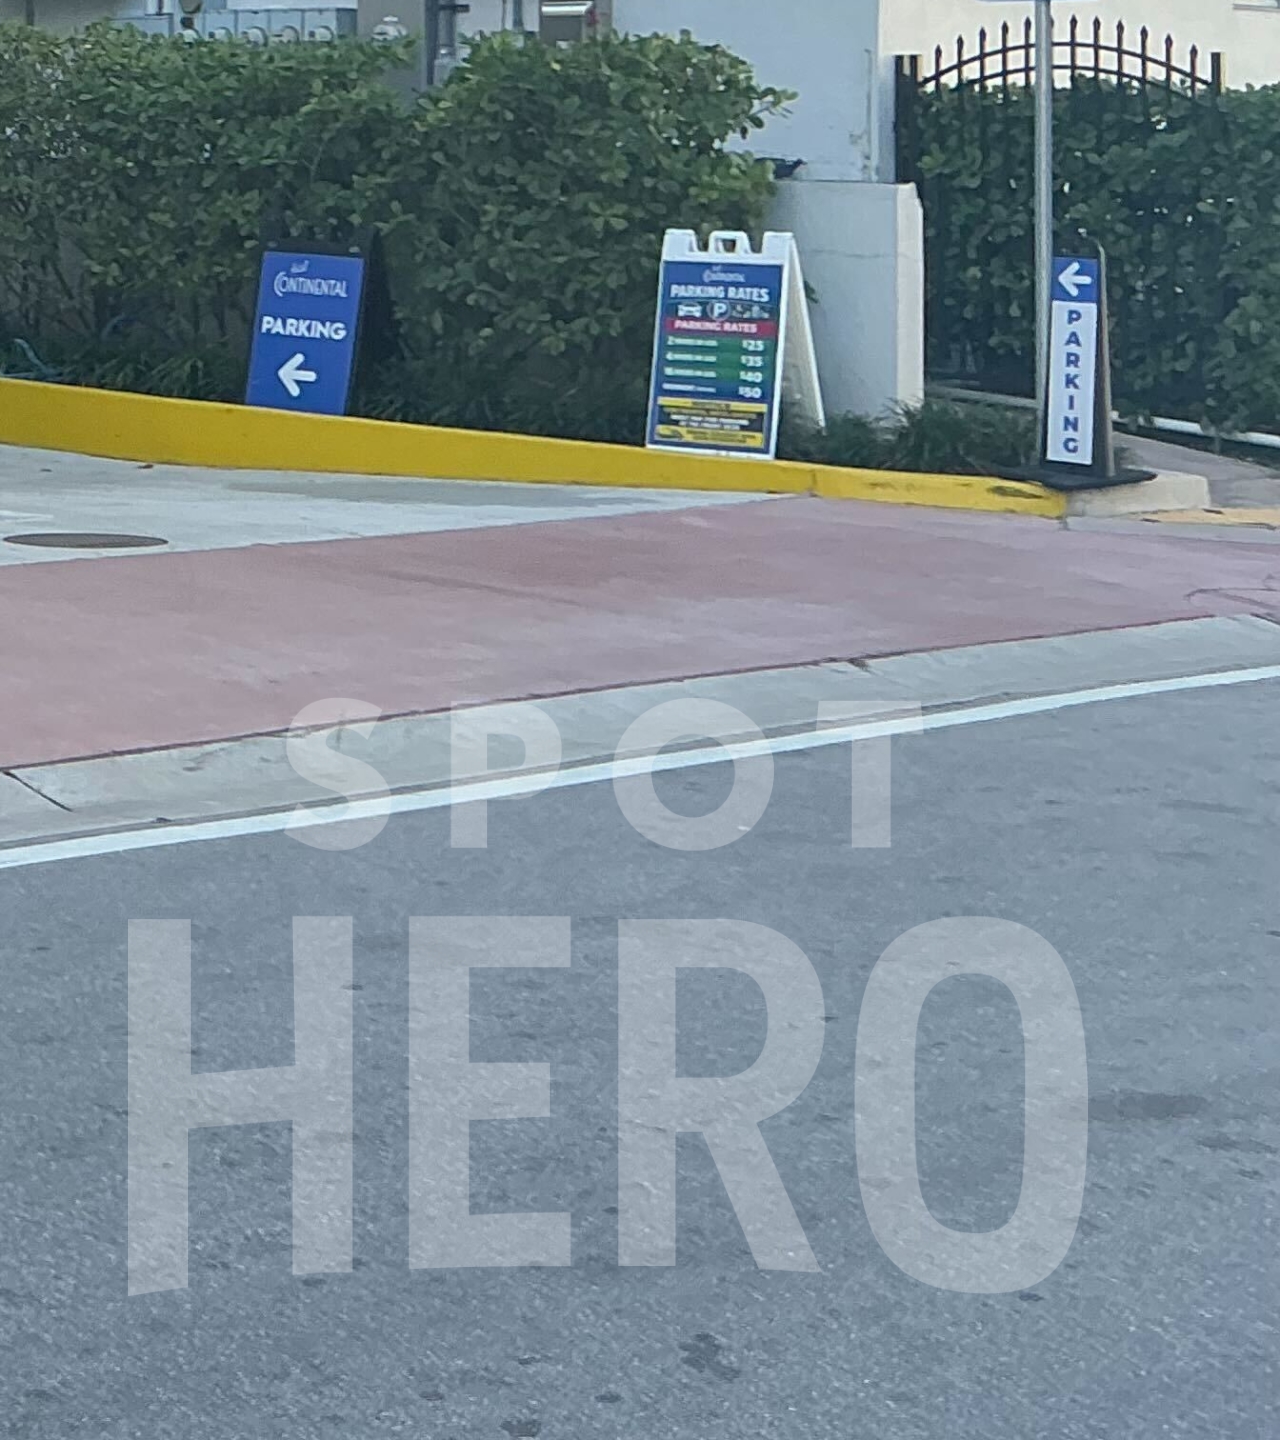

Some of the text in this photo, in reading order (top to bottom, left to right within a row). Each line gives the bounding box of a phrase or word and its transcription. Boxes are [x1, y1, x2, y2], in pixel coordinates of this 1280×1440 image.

[274, 271, 348, 297] CONTINENTAL
[670, 284, 770, 302] PARKING RATES
[261, 316, 347, 340] PARKING
[674, 319, 758, 333] PARKING RATES
[1062, 310, 1082, 453] PARKING
